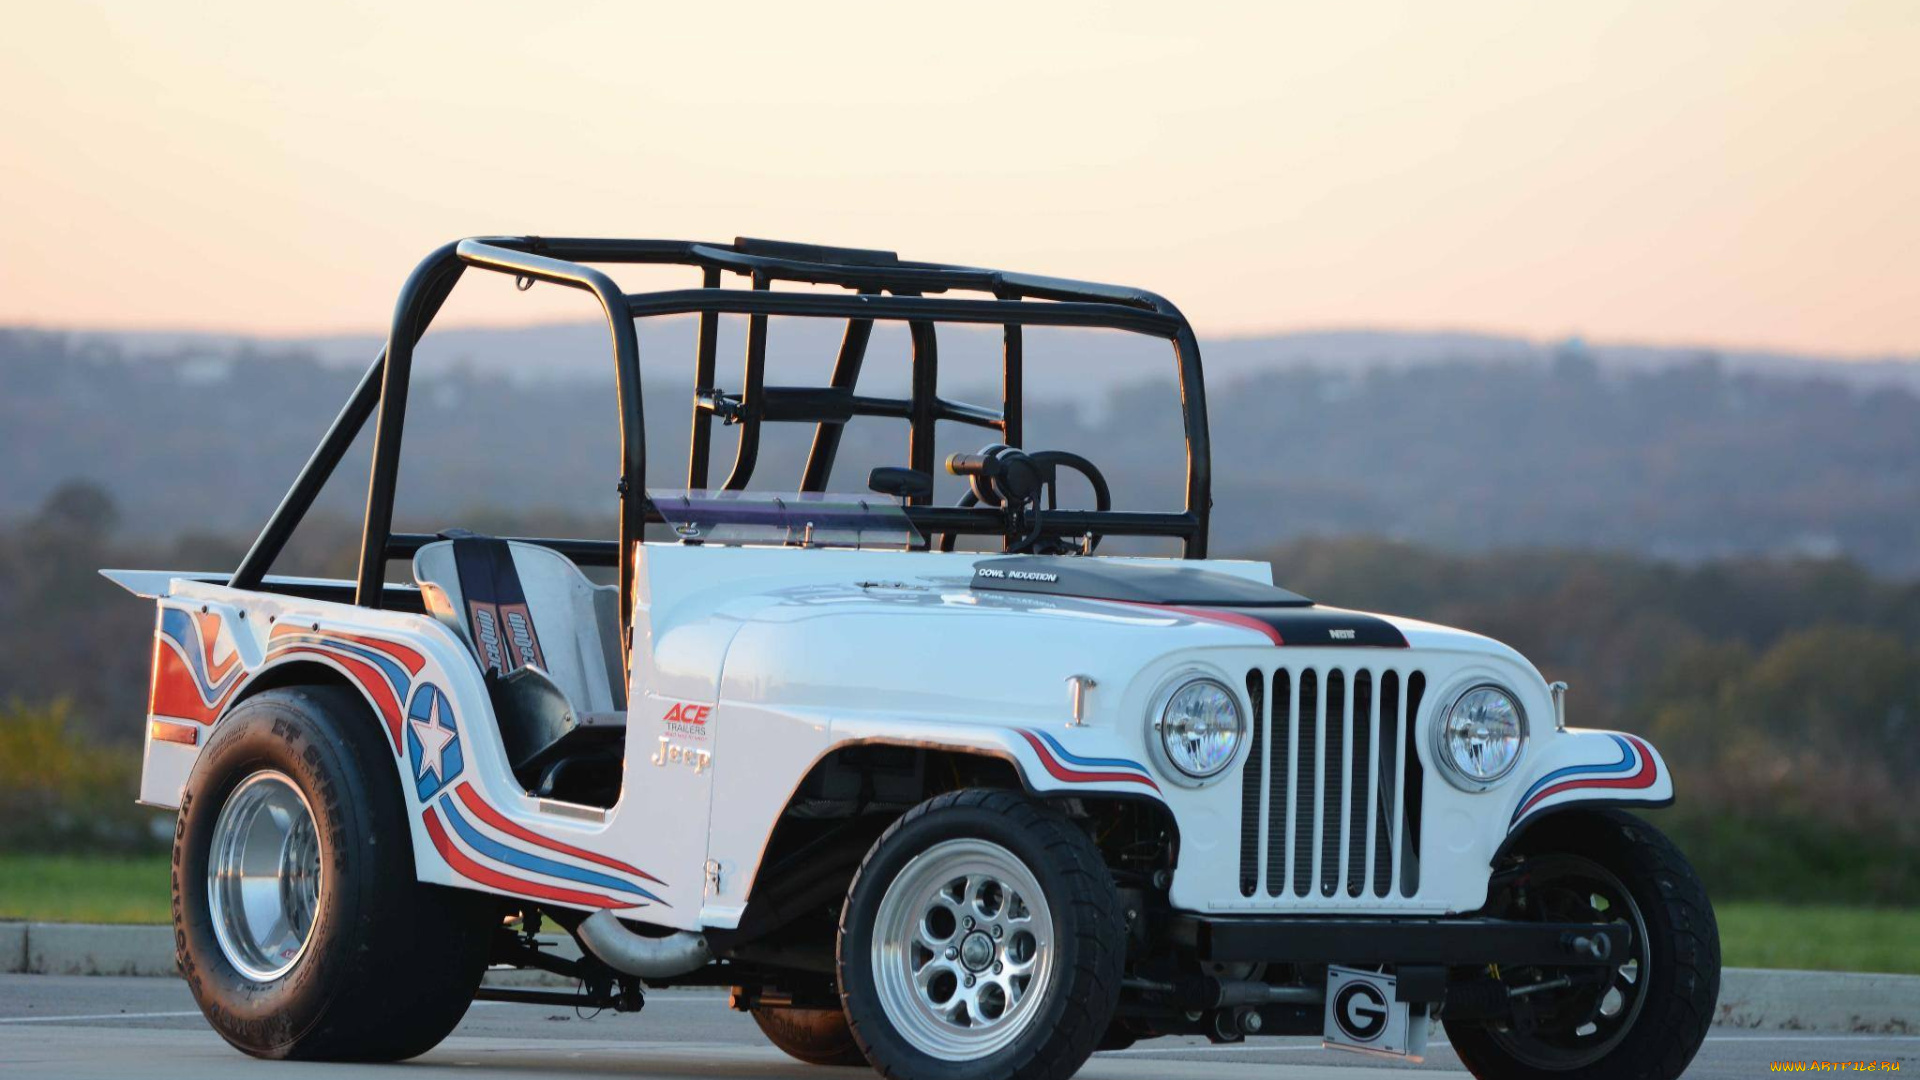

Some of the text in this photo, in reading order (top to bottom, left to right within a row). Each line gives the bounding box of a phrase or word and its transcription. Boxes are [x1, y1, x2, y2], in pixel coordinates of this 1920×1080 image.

[979, 568, 1058, 582] COWL INDUCTION
[662, 702, 712, 725] ACE
[667, 722, 706, 736] TRAILERS
[651, 736, 711, 773] Jeep
[271, 717, 302, 744] ET
[303, 744, 347, 873] STREET
[1335, 983, 1386, 1039] G
